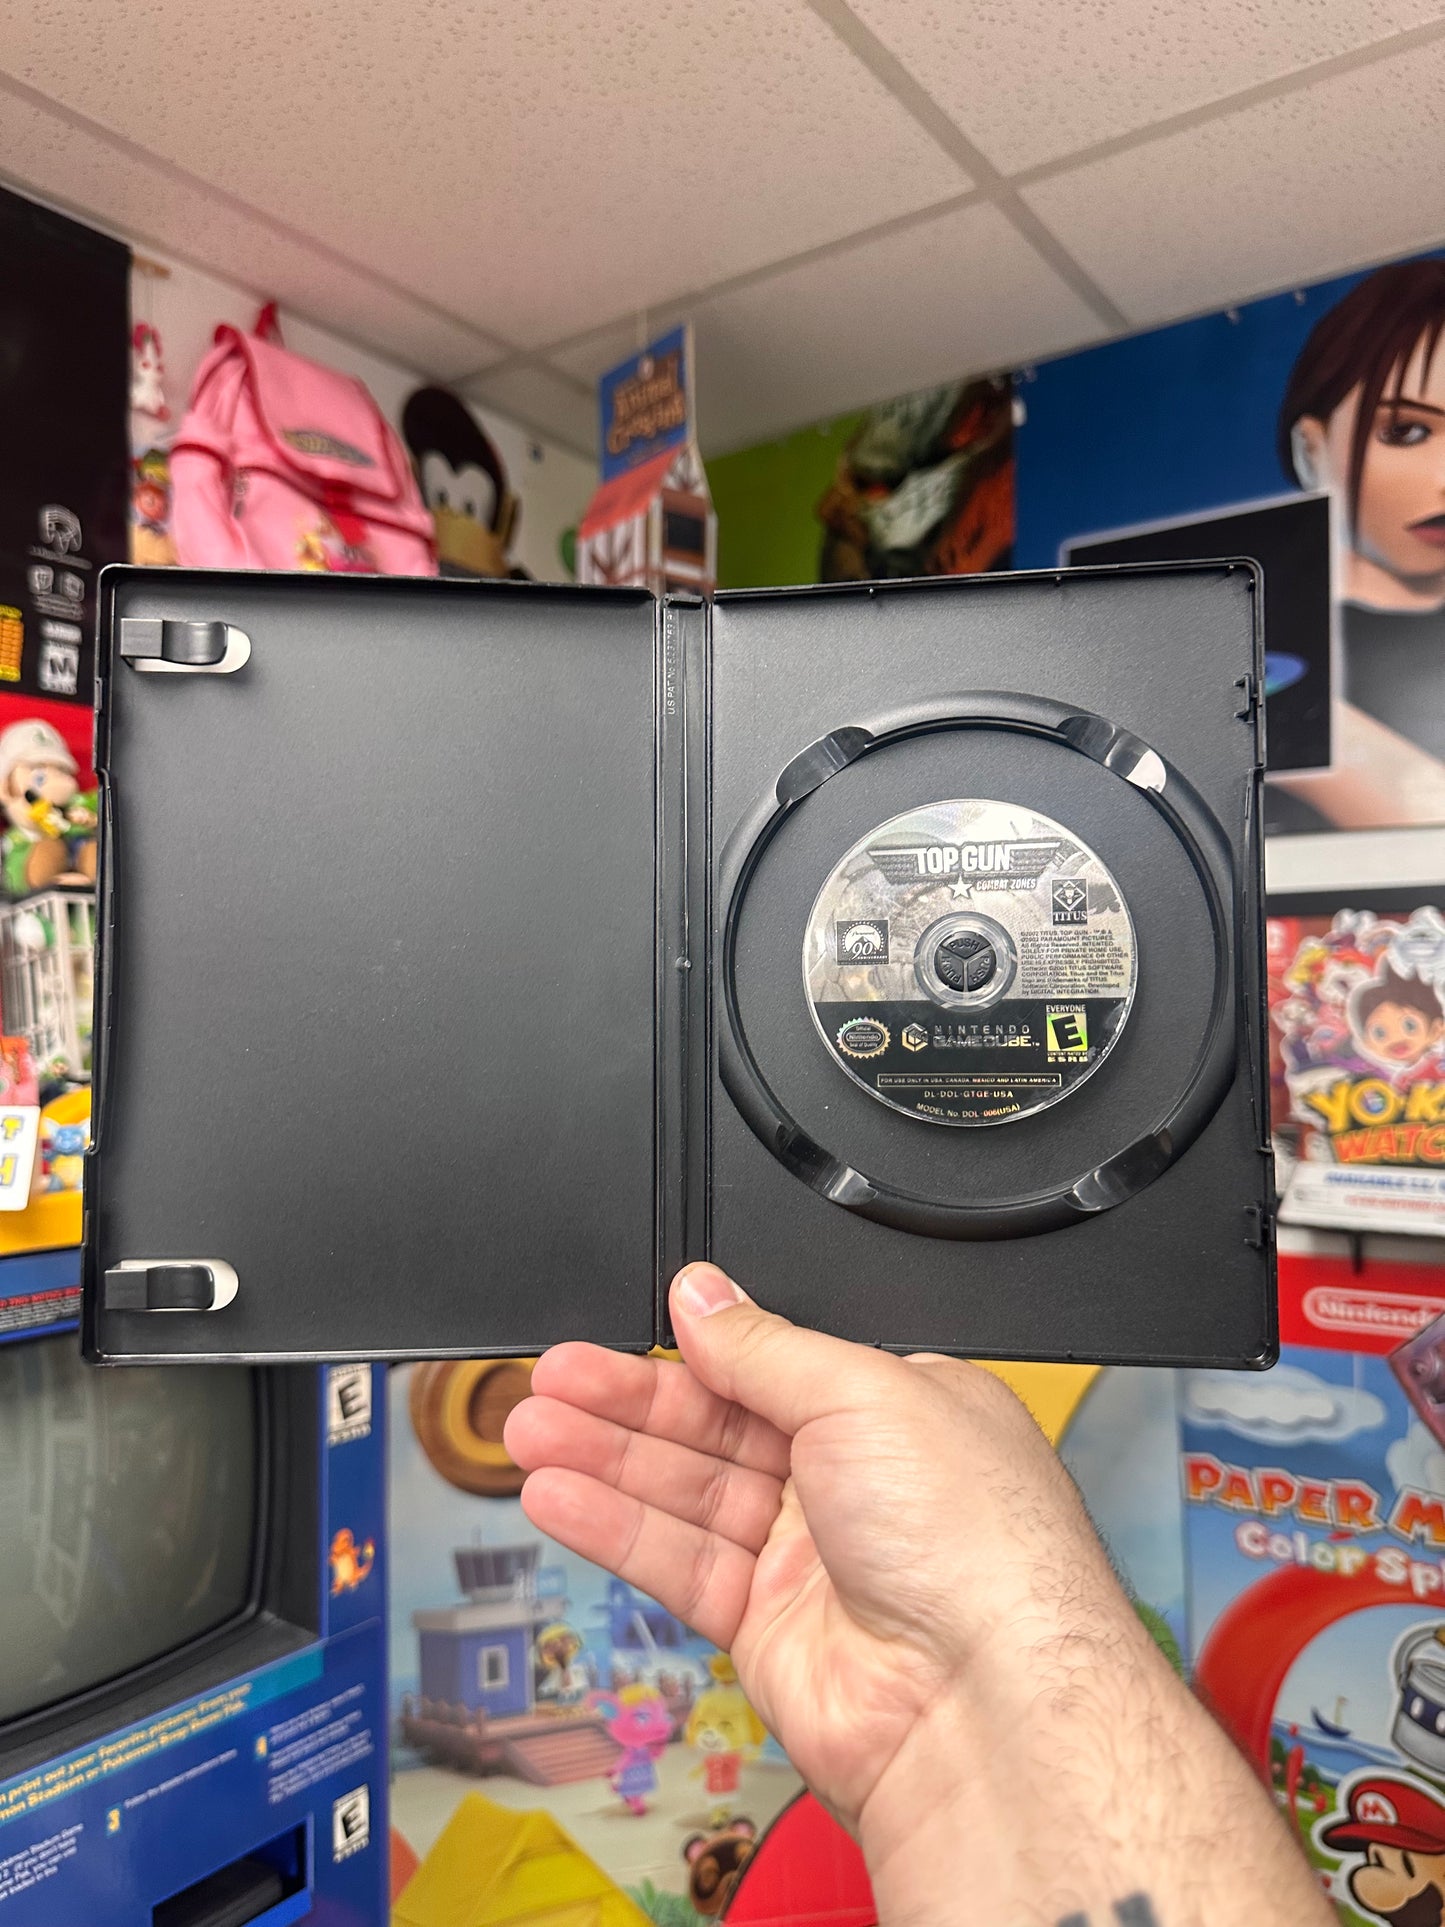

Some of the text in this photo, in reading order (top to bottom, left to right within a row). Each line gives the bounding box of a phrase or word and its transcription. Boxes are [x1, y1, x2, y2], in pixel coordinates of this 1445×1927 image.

[667, 680, 675, 698] PAT
[667, 700, 675, 715] US
[915, 843, 1011, 875] TOP GUN
[976, 879, 1008, 891] COMBAT
[1053, 911, 1087, 921] TITUS
[949, 937, 980, 950] PUSH
[934, 1025, 1030, 1034] NINTENDO
[1051, 1015, 1083, 1050] E
[916, 1103, 945, 1115] MODEL
[1183, 1453, 1386, 1534] PAPER
[1235, 1520, 1367, 1577] Color
[8, 1777, 42, 1802] print
[28, 1774, 84, 1807] Stadium
